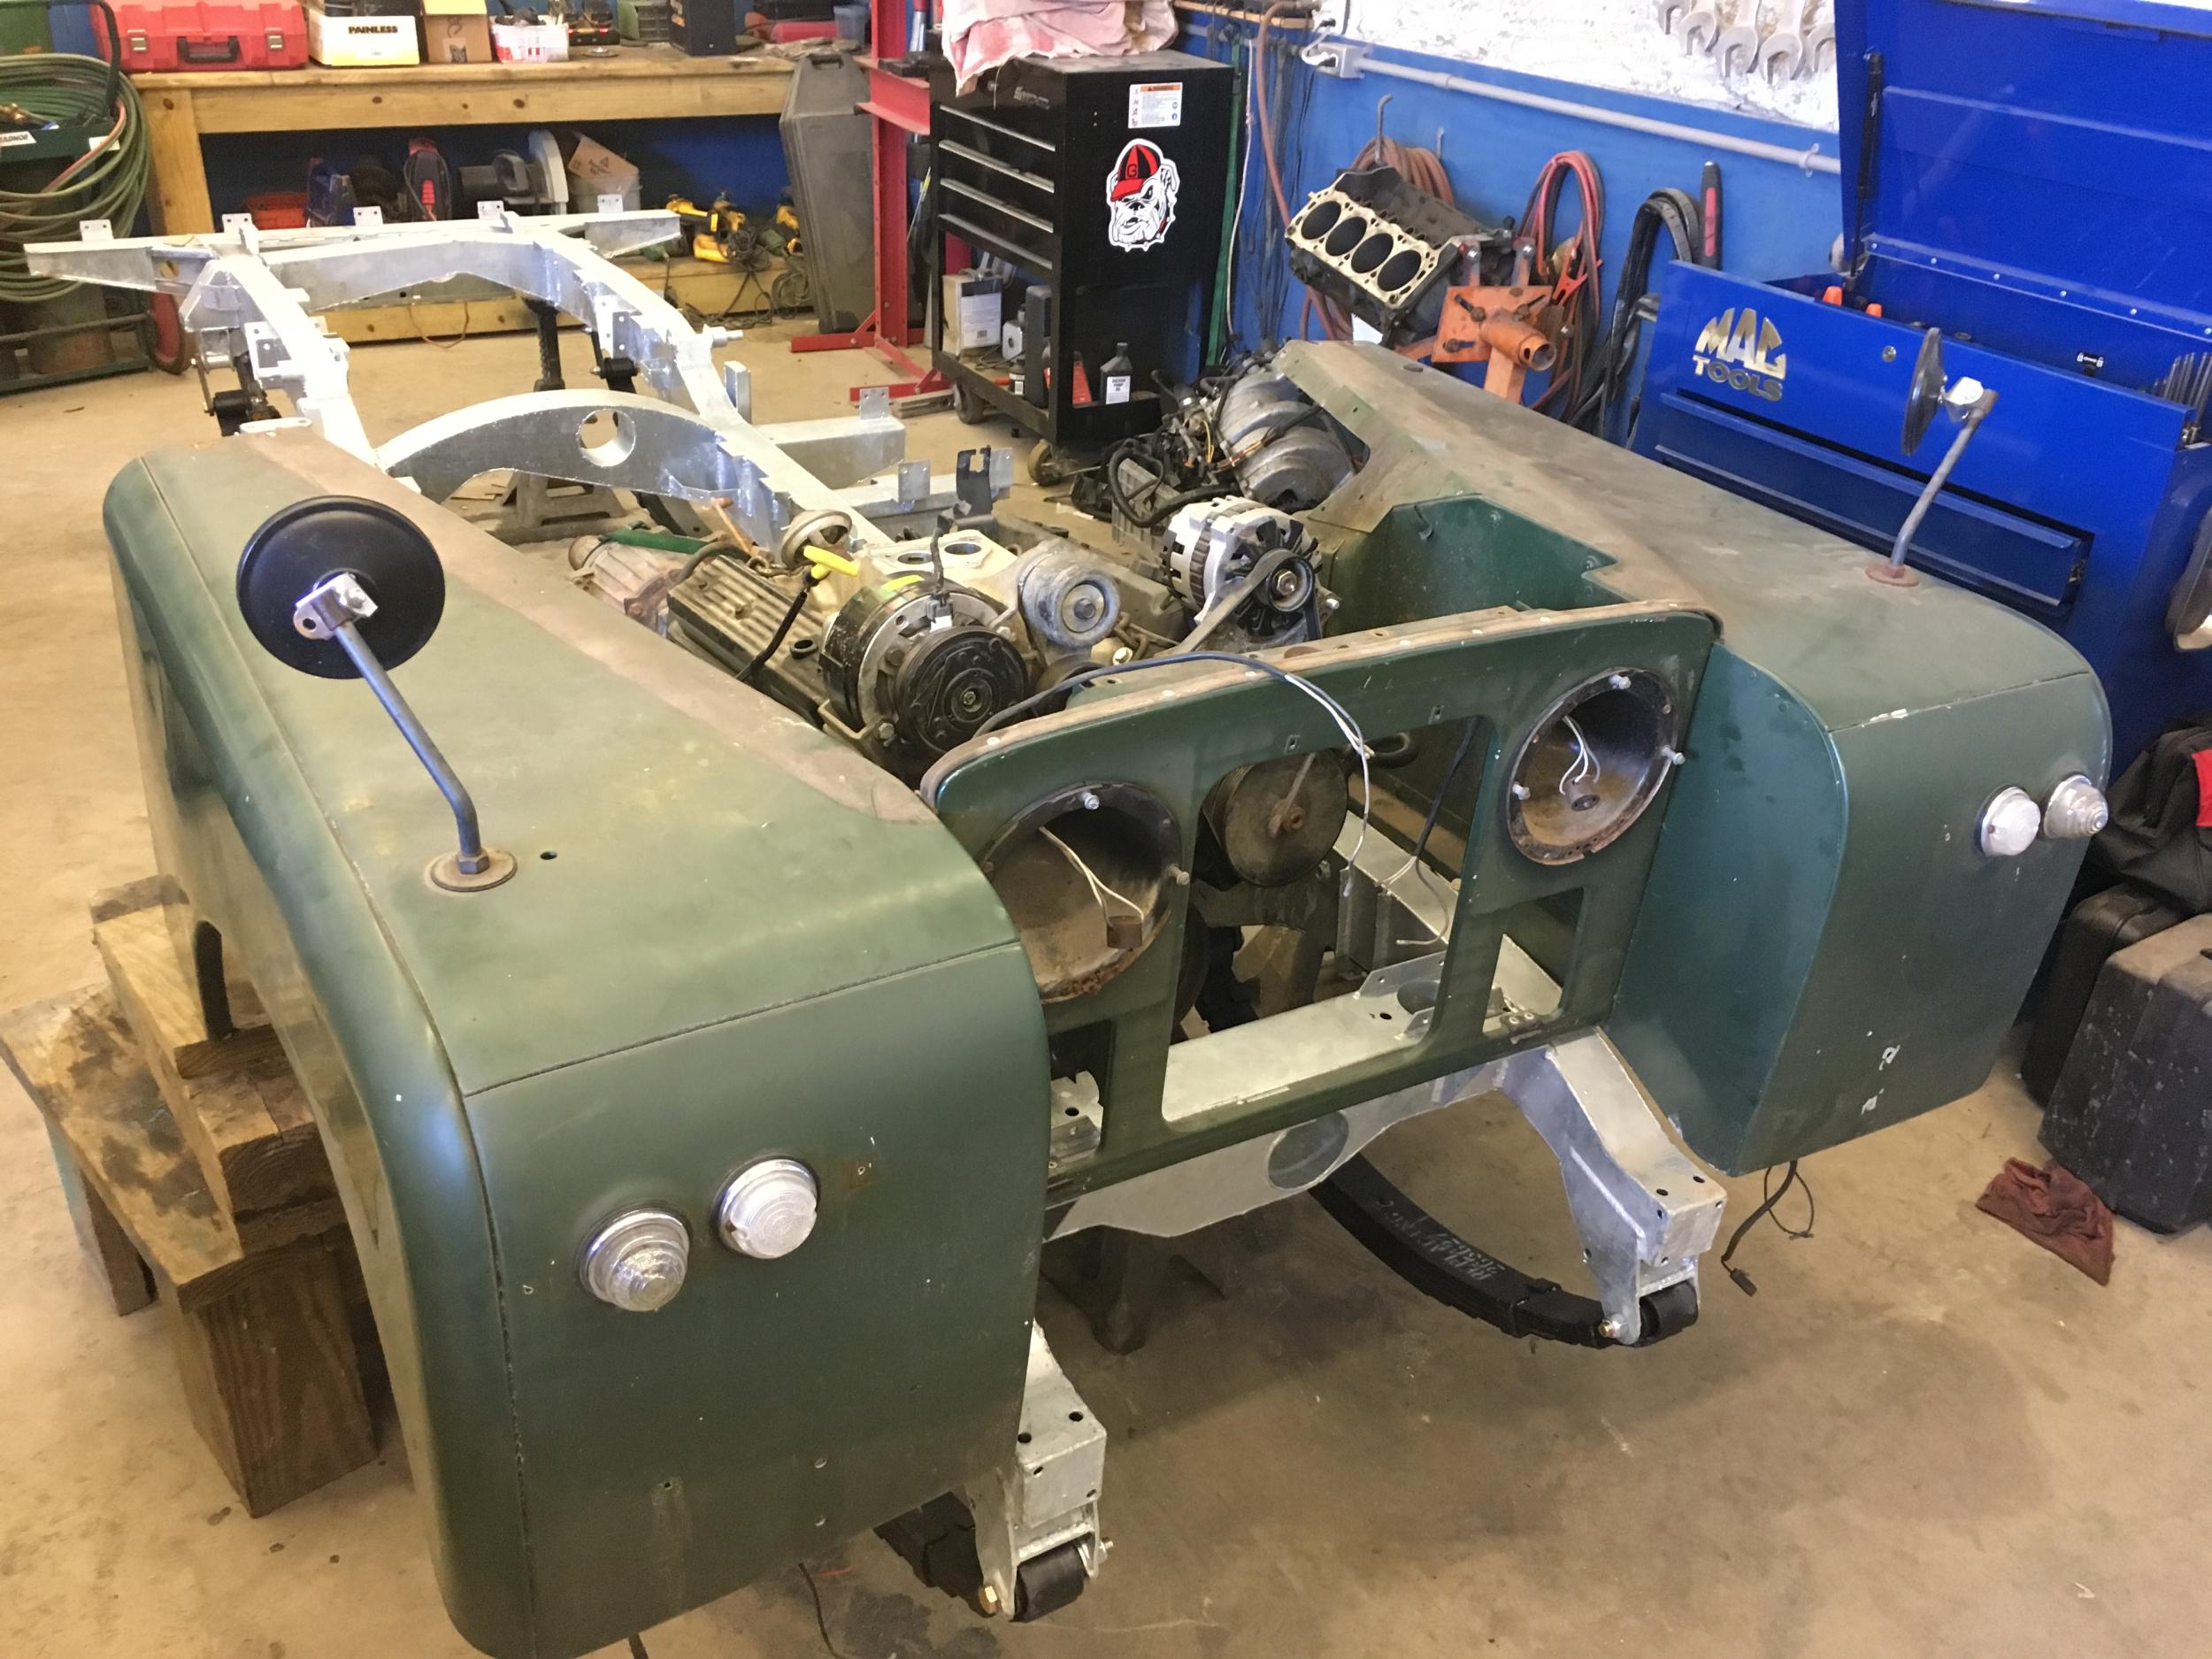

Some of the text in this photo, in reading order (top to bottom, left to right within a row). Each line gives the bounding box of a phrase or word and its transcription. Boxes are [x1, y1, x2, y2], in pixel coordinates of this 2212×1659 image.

[348, 26, 398, 35] PAINLESS
[1127, 164, 1137, 178] G
[1694, 307, 1786, 380] MAC
[1693, 354, 1783, 402] TOOLS
